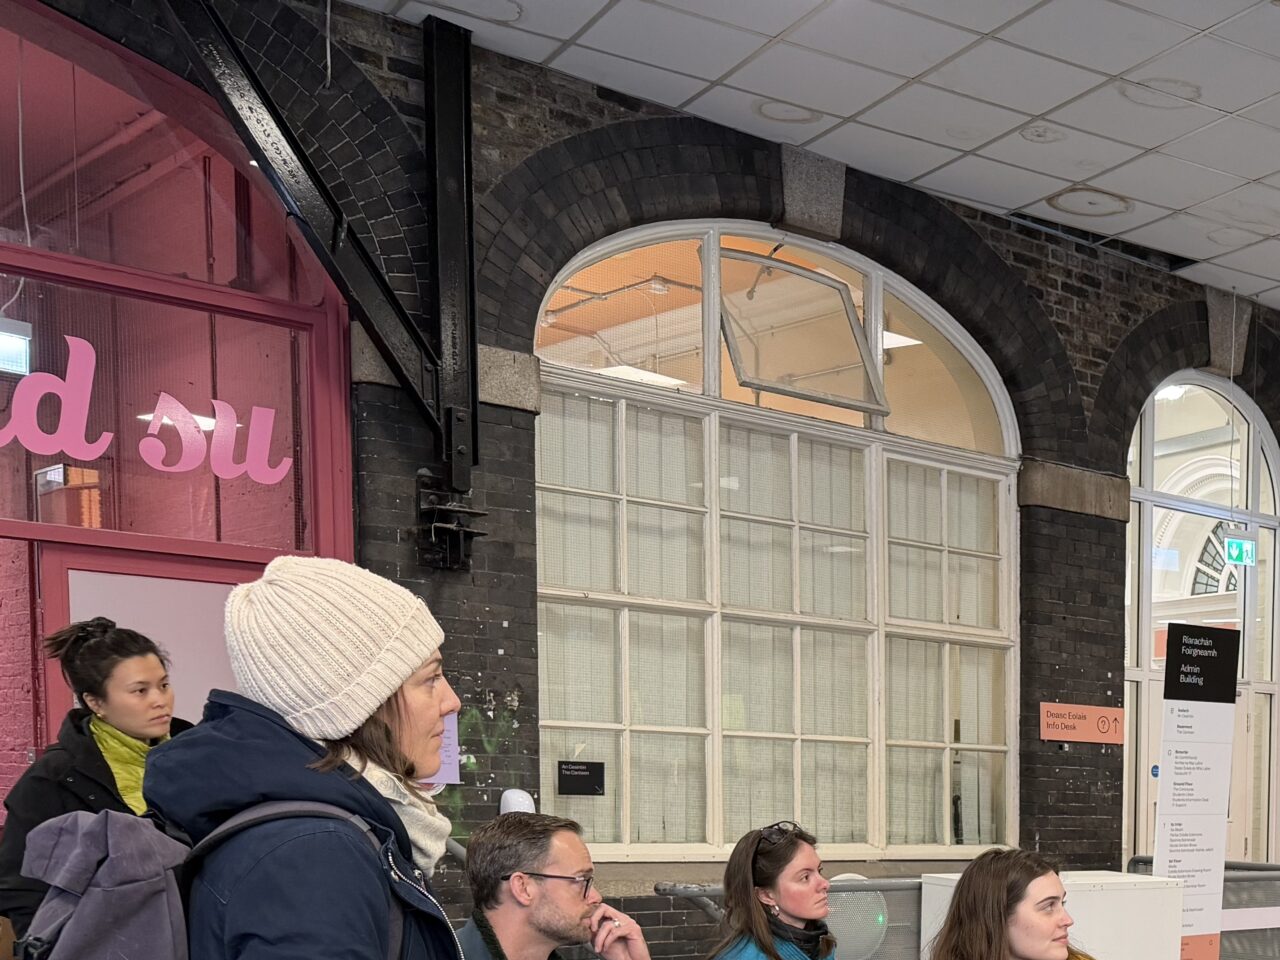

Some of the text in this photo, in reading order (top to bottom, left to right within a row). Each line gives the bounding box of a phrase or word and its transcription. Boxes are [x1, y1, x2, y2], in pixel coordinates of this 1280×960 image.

[0, 335, 293, 485] d su
[1180, 664, 1201, 673] Admin
[1180, 674, 1204, 686] Building
[1046, 711, 1087, 721] Deasc Eolais
[1046, 722, 1077, 731] Info Desk
